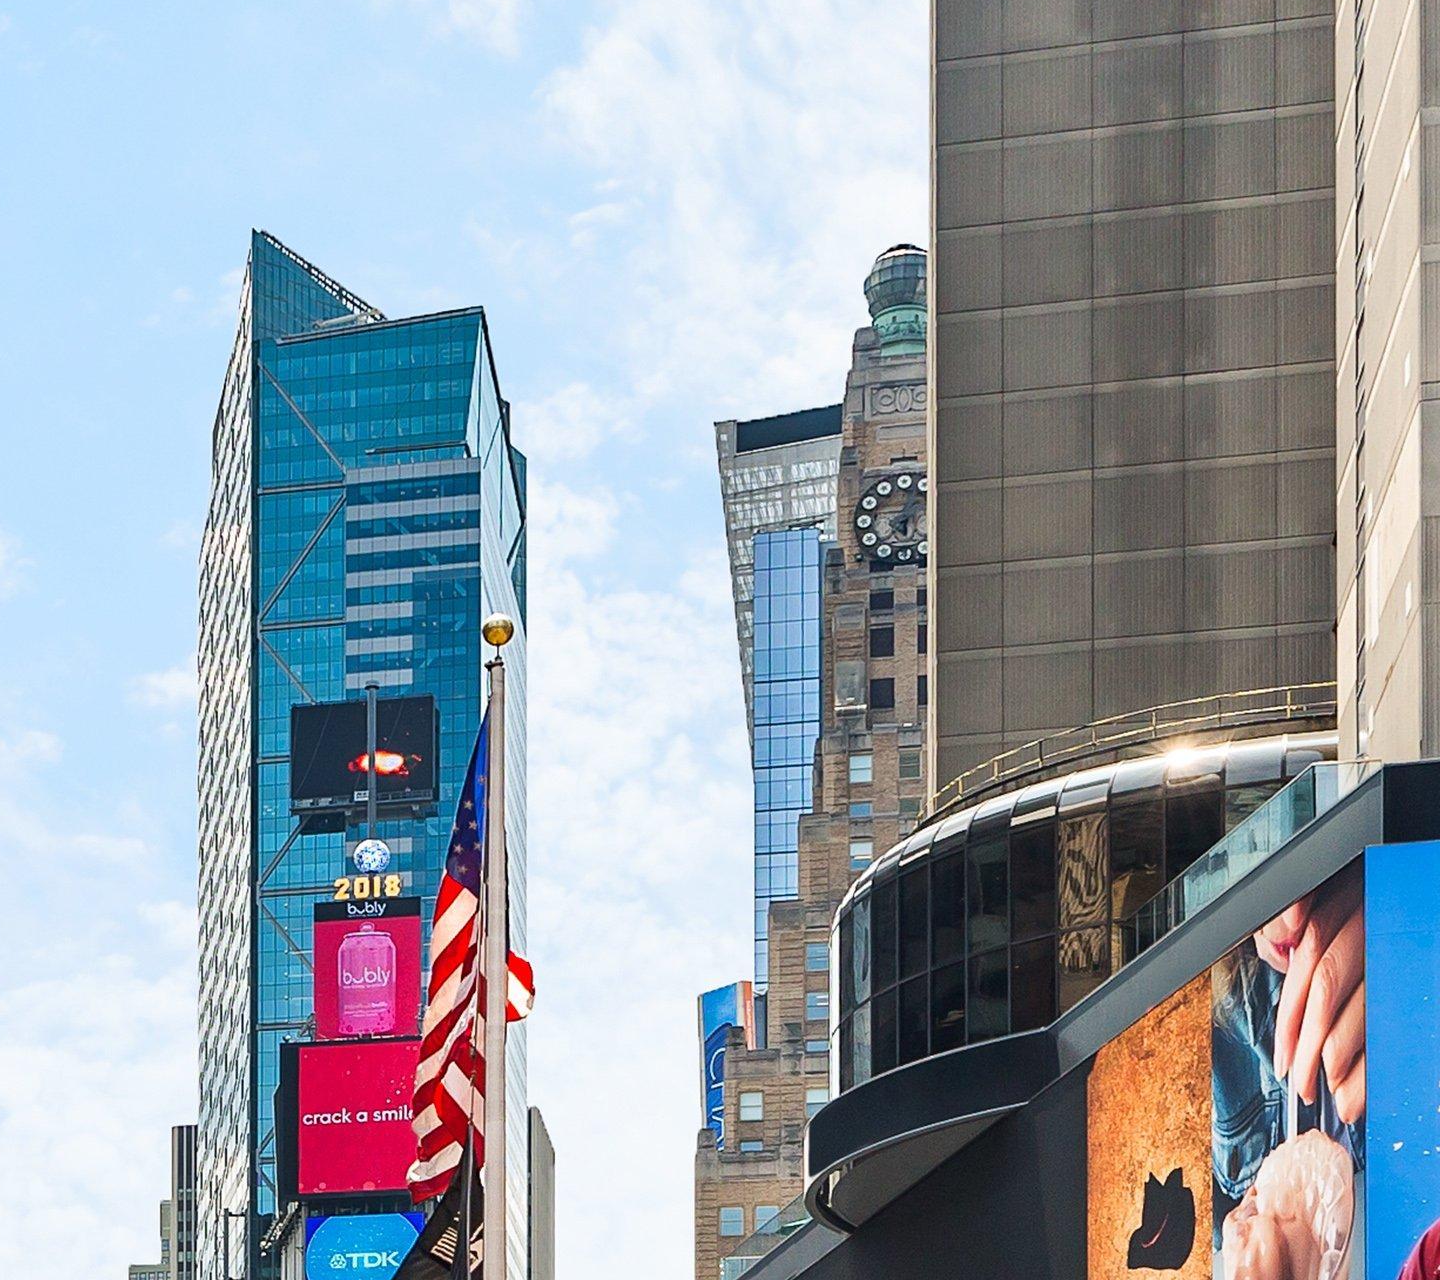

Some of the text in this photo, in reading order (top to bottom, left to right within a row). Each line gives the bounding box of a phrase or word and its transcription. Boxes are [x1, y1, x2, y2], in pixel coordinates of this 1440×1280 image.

[335, 874, 401, 901] 2018
[302, 1109, 351, 1126] crack
[357, 1112, 367, 1123] a
[346, 1251, 399, 1268] TDK
